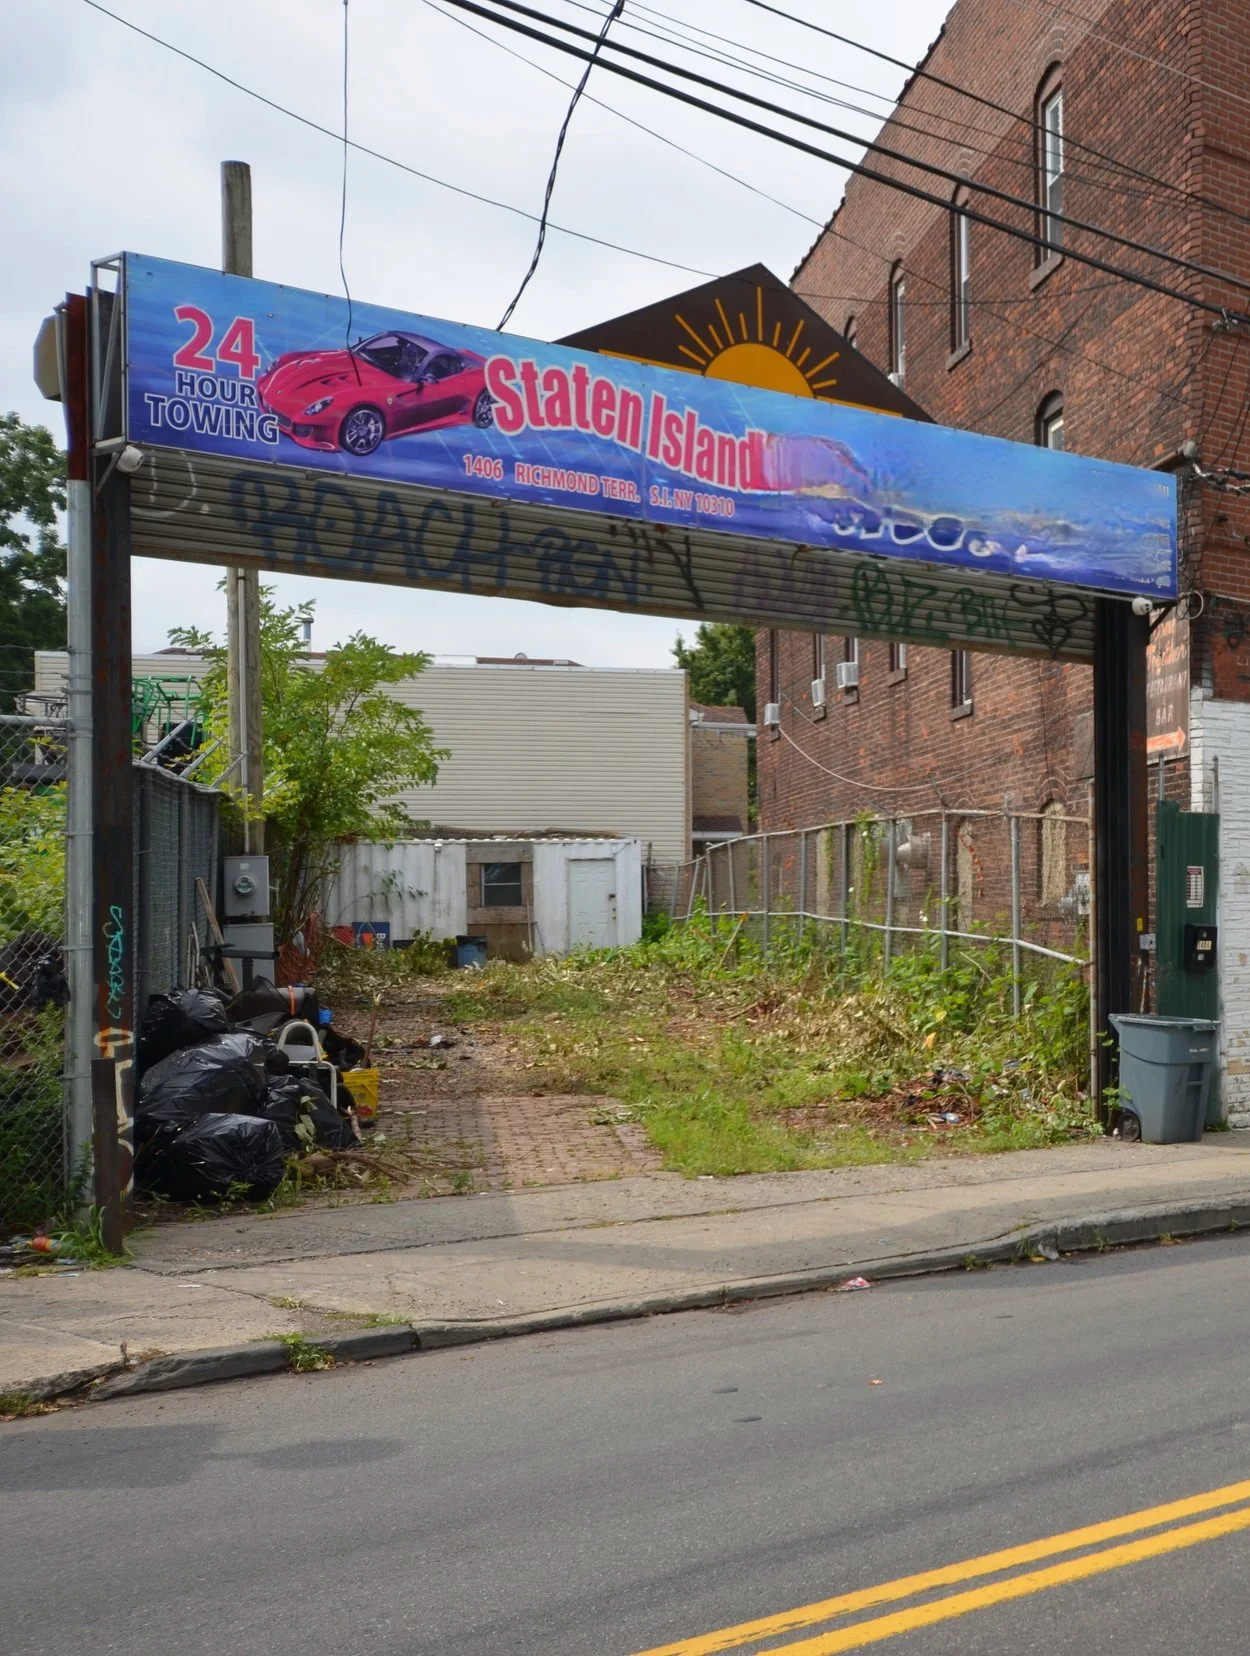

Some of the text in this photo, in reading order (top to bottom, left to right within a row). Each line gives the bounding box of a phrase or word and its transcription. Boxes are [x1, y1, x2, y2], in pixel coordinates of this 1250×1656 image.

[173, 304, 260, 380] 24
[145, 394, 279, 445] TOWING
[175, 371, 258, 408] HOUR
[484, 353, 770, 494] Staten Island
[463, 454, 504, 480] 1406
[515, 462, 599, 497] RICHMOND
[601, 477, 641, 504] TERR.
[673, 489, 694, 511] NY
[695, 493, 736, 518] 10310
